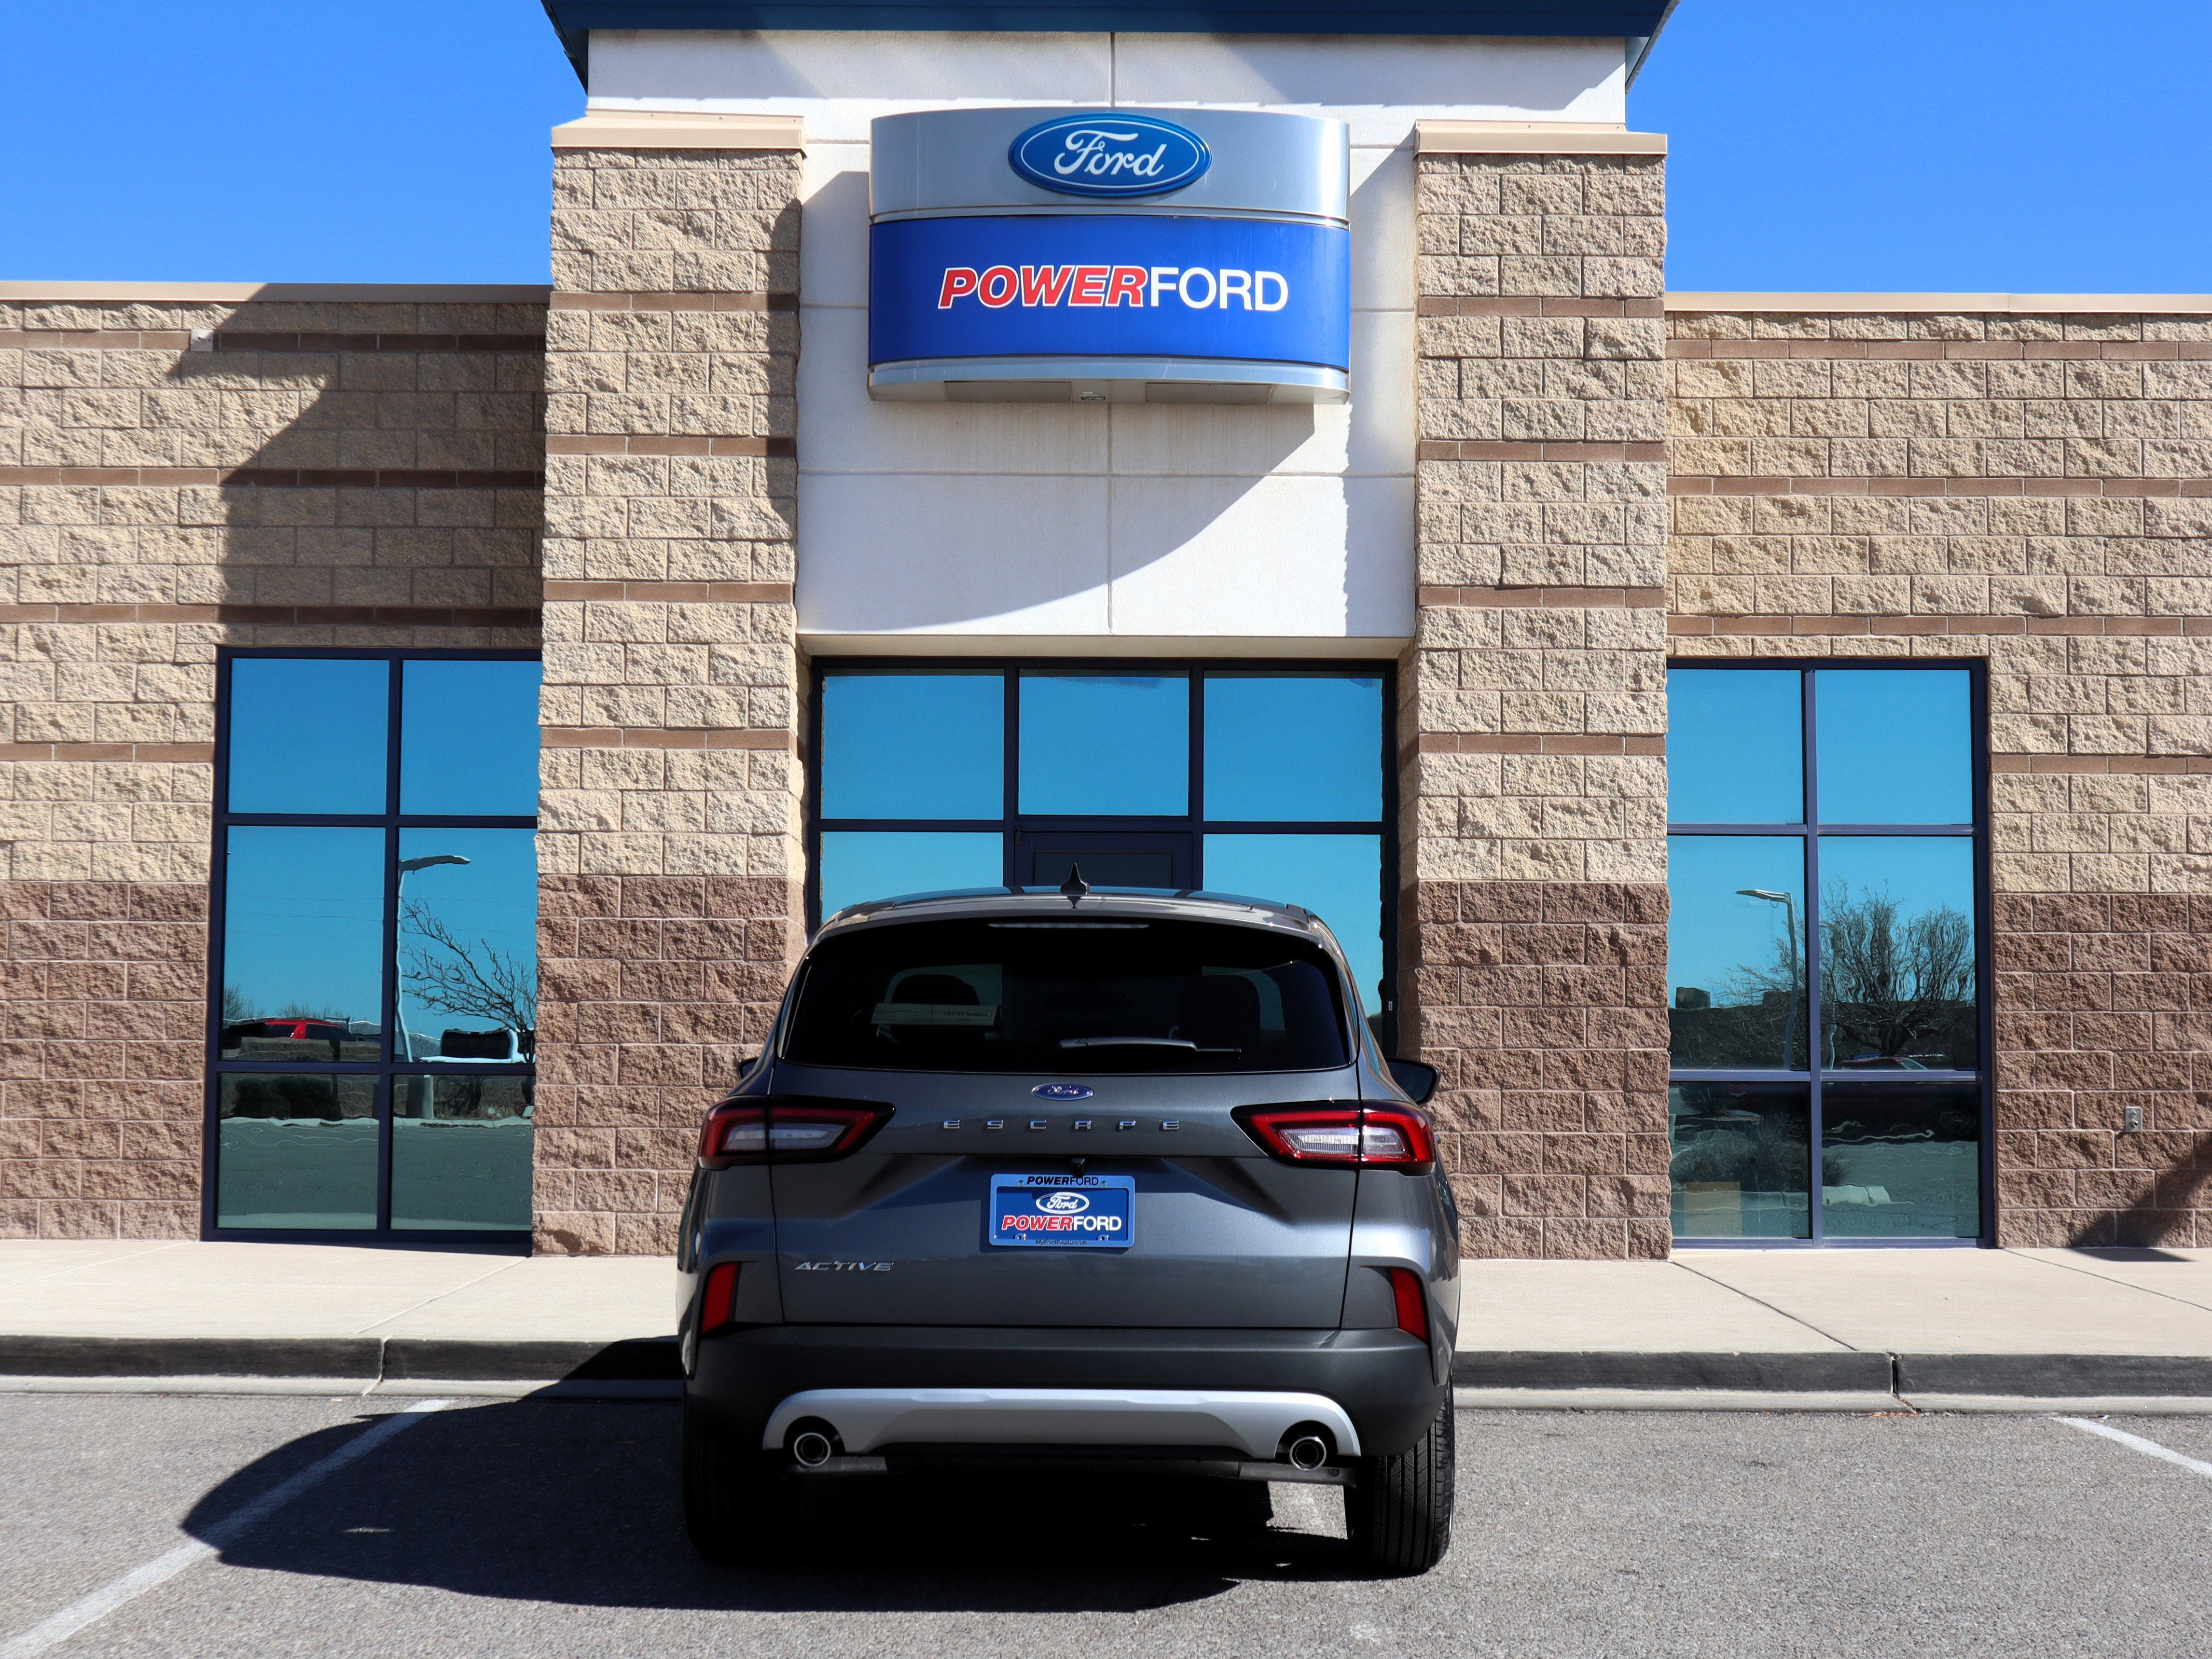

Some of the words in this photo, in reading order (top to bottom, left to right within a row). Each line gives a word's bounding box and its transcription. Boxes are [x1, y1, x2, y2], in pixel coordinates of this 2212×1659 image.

[1054, 129, 1164, 177] Ford
[937, 264, 1289, 311] POWERFORD
[1047, 1086, 1079, 1096] Ford
[943, 1119, 1179, 1130] ESCAPE
[1026, 1176, 1099, 1186] POWERFORD
[1046, 1195, 1078, 1210] Ford
[1001, 1215, 1122, 1231] POWERFORD
[794, 1260, 895, 1271] ACTIVE
